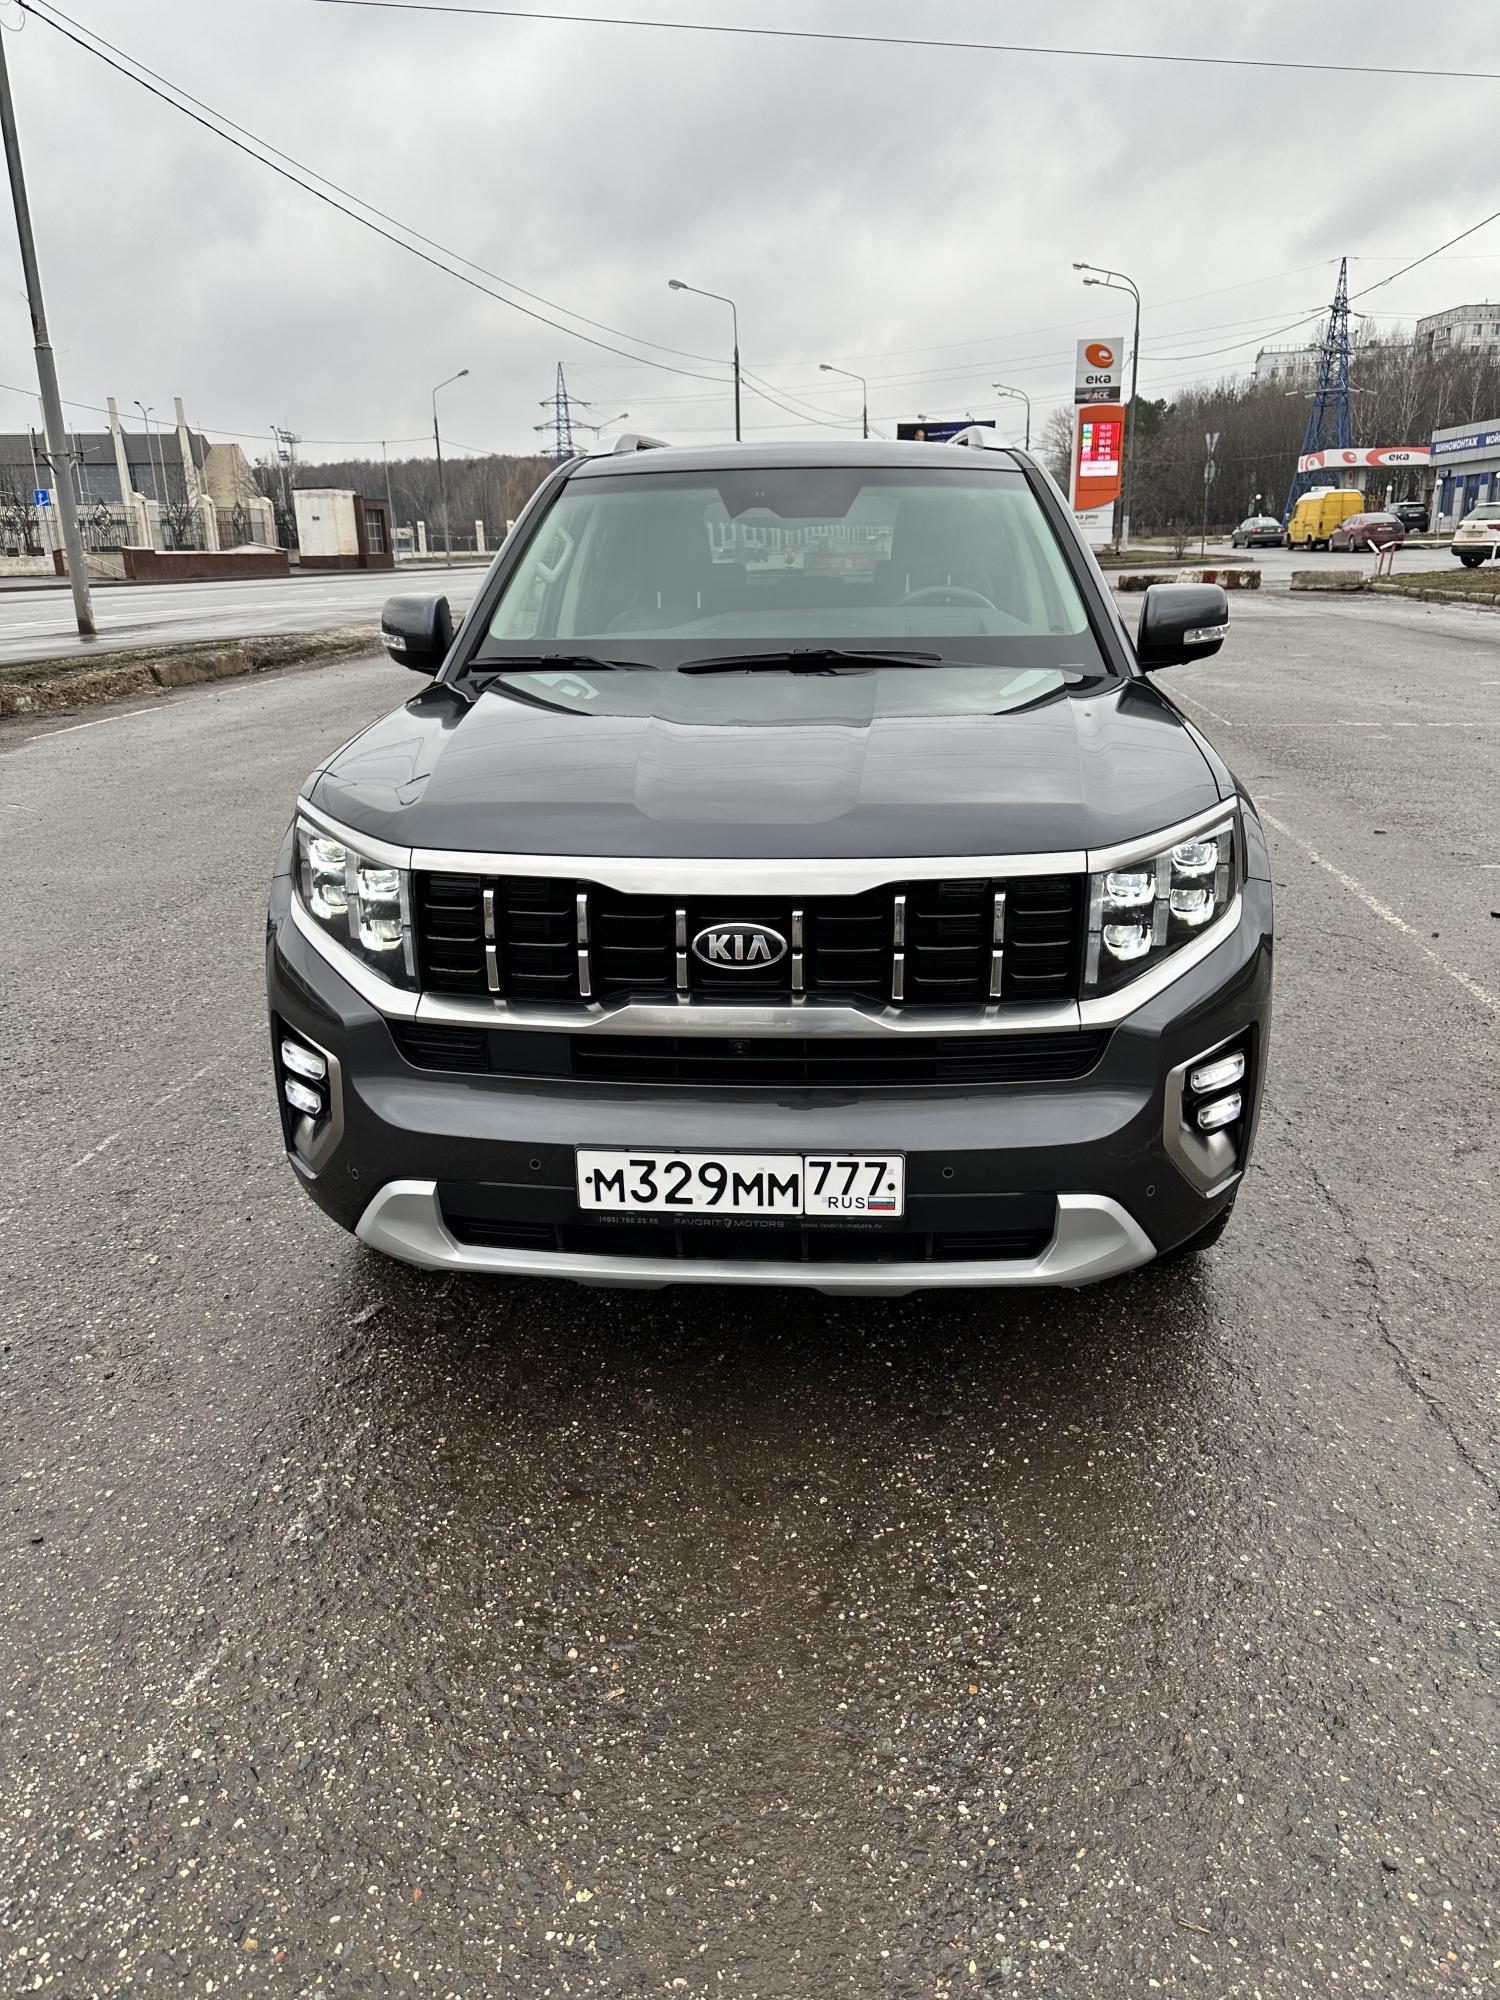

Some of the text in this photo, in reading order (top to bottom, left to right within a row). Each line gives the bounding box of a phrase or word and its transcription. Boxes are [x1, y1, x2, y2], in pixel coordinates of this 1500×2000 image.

[1435, 432, 1500, 452] ШИНОМОНТАЖ МОЙ
[708, 934, 772, 960] KIA
[593, 1159, 888, 1208] М329ММ 777
[827, 1196, 866, 1209] RUS
[599, 1216, 619, 1224] (495)
[673, 1218, 785, 1229] FAVORIT MOTORS
